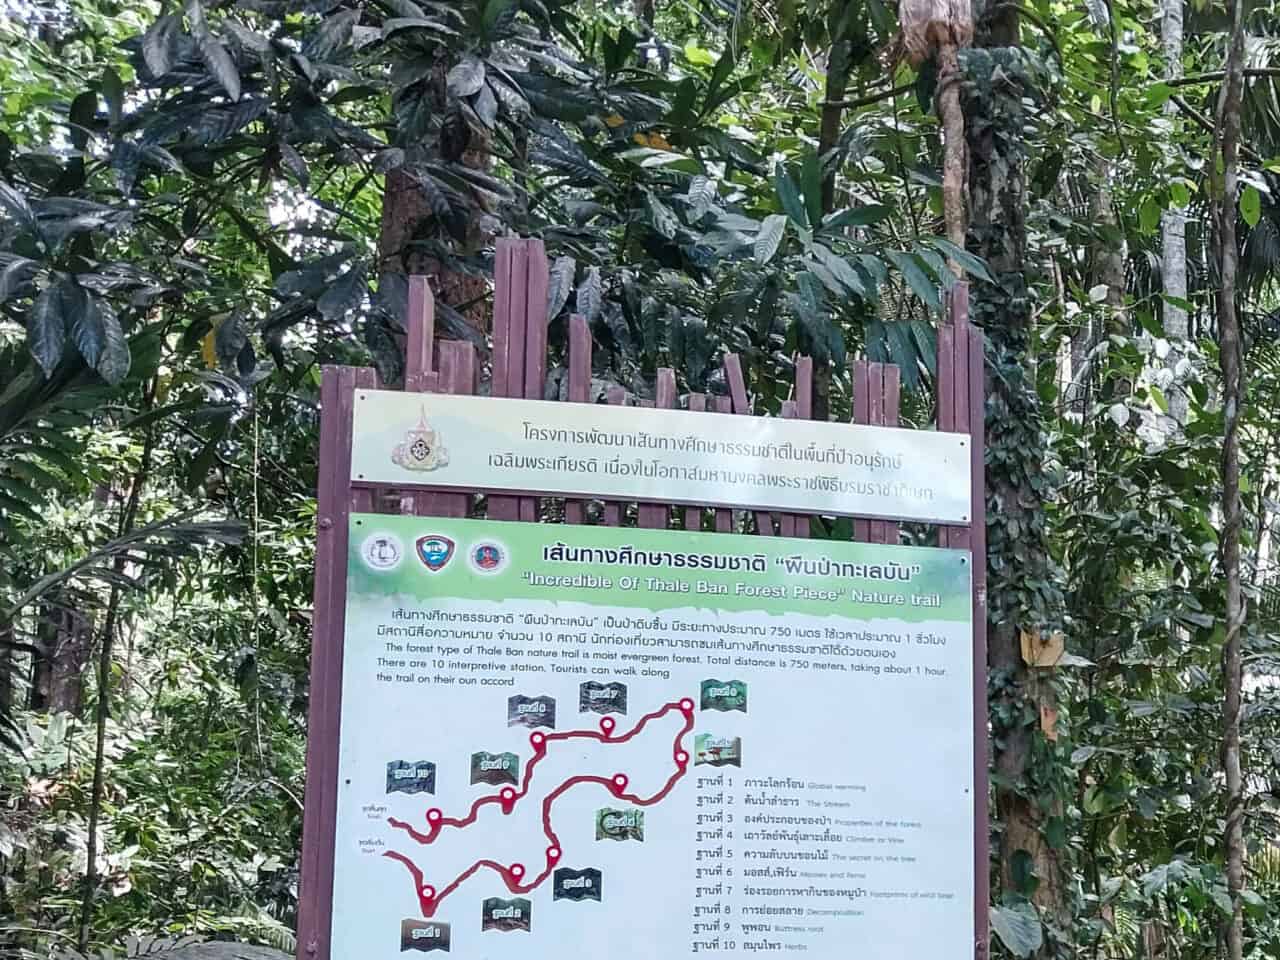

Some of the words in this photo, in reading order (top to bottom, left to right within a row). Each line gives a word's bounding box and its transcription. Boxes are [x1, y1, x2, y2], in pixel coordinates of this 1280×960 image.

[488, 452, 598, 474] เฉลิมพระเกียรติ
[543, 542, 766, 573] เส้นทางศึกษาธรรมชาติ
[619, 575, 638, 592] Of
[646, 578, 689, 593] Thale
[697, 580, 728, 595] Ban
[736, 582, 786, 598] Forest
[853, 588, 904, 605] Nature
[912, 592, 941, 608] trail
[539, 632, 553, 643] 10
[770, 627, 791, 637] 750
[796, 629, 820, 639] เมตร
[376, 657, 405, 668] There
[410, 660, 426, 668] are
[432, 659, 445, 669] 10
[449, 660, 506, 672] interpretive
[551, 664, 587, 675] Tourists
[591, 667, 610, 675] can
[614, 666, 637, 676] walk
[641, 667, 670, 680] along
[386, 642, 402, 653] The
[406, 644, 433, 655] forest
[437, 645, 460, 659] type
[463, 645, 473, 656] of
[476, 646, 502, 657] Thale
[505, 648, 524, 658] Ban
[527, 649, 557, 659] nature
[561, 649, 579, 660] trail
[583, 650, 590, 660] is
[593, 651, 617, 662] moist
[621, 653, 669, 664] evergreen
[708, 655, 731, 667] Total
[734, 656, 776, 668] distance
[779, 658, 787, 668] is
[791, 659, 809, 669] 750
[851, 662, 880, 675] taking
[884, 663, 912, 675] about
[376, 673, 392, 682] the
[396, 673, 414, 683] trail
[417, 676, 430, 684] on
[434, 674, 455, 684] their
[481, 677, 514, 687] accord
